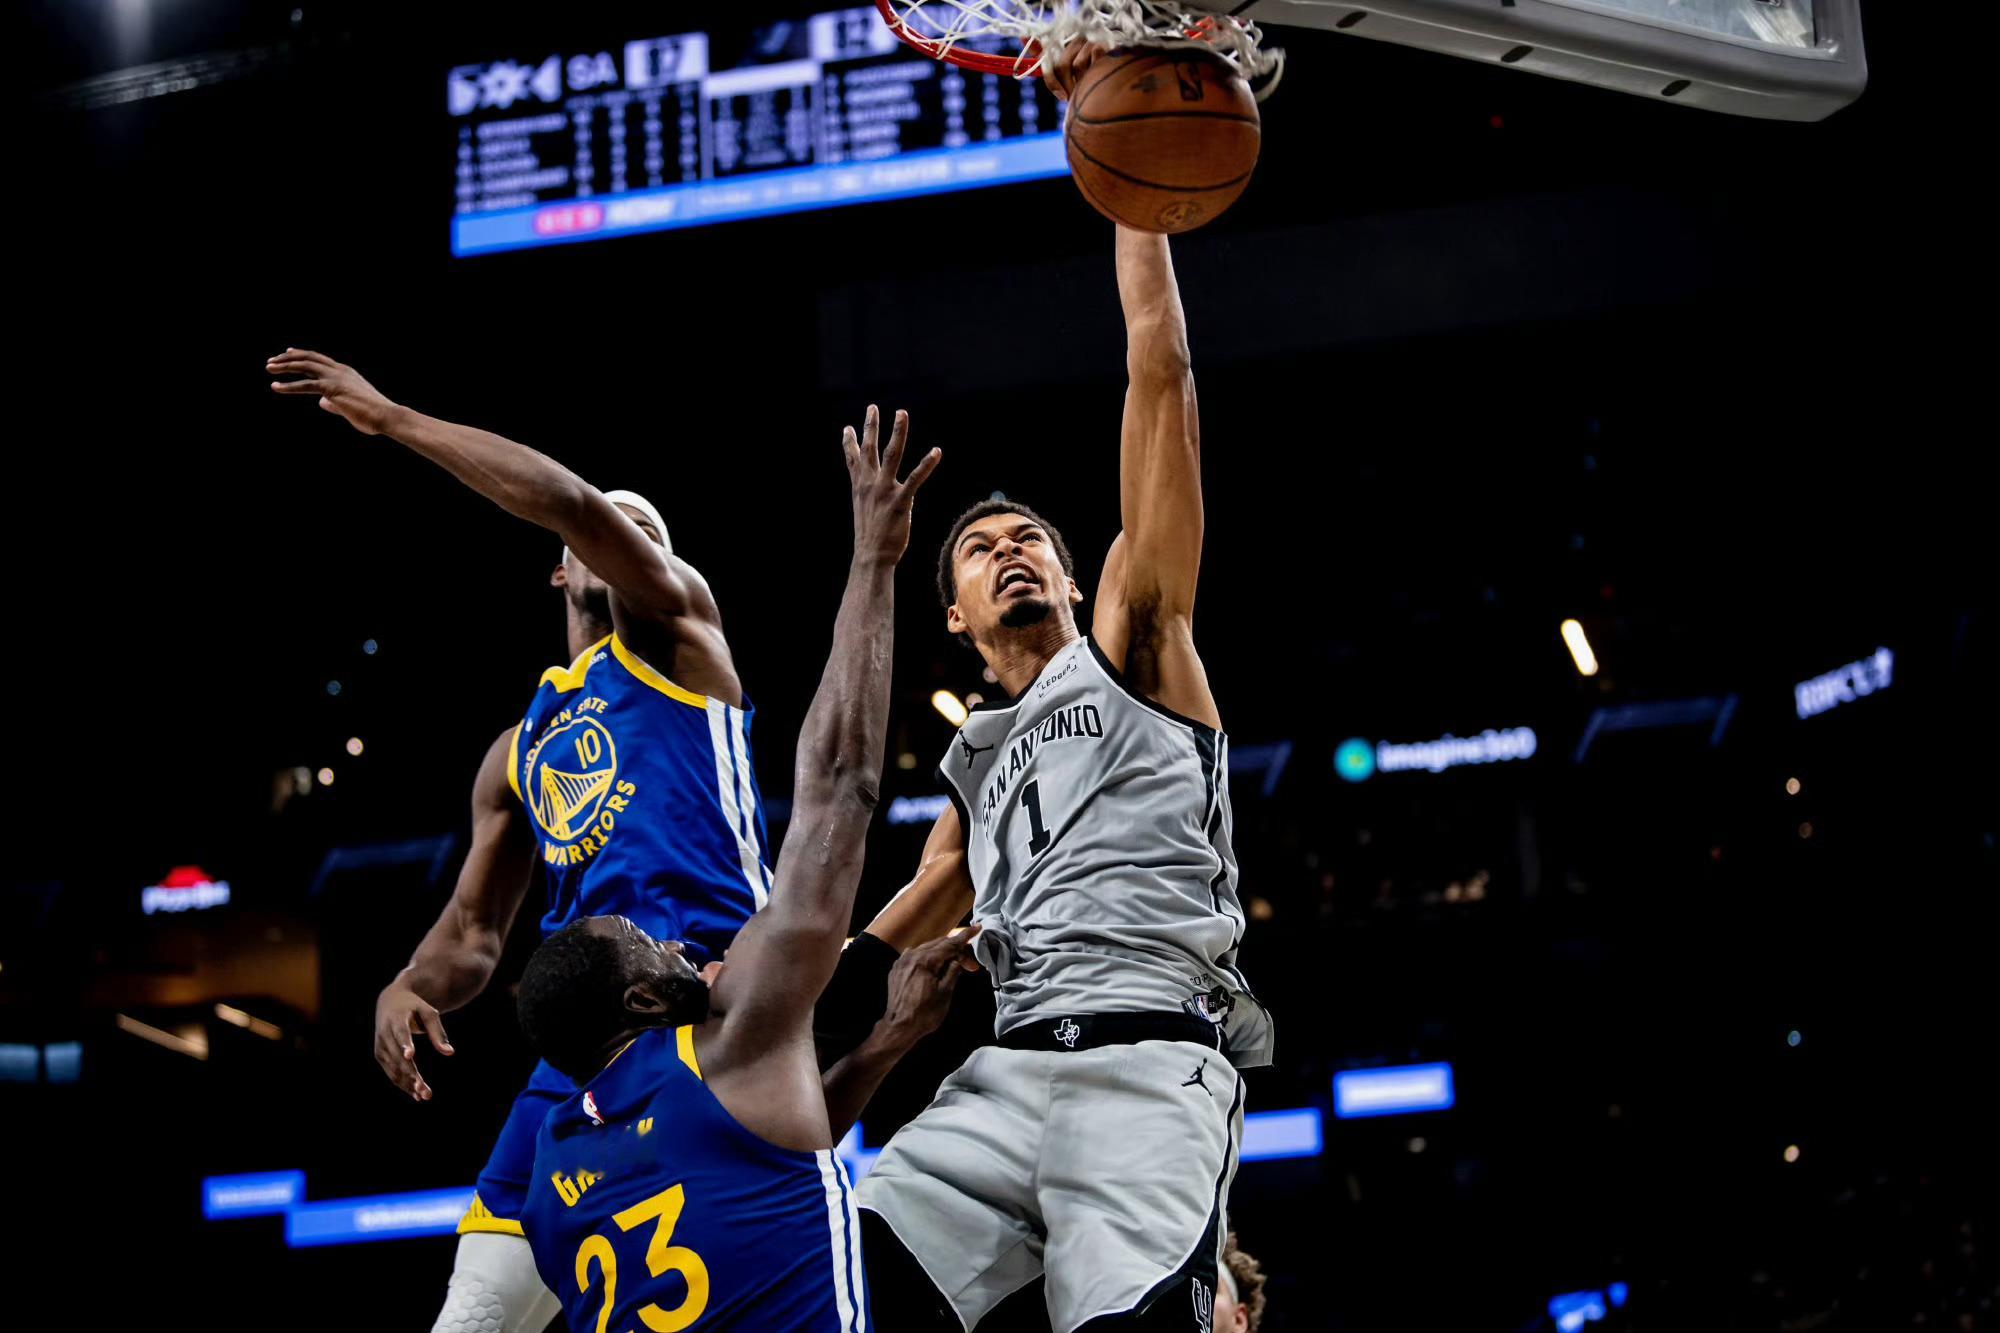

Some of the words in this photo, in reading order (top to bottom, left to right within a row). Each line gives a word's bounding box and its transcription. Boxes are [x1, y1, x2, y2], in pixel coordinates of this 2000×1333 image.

[566, 52, 618, 91] SA
[1041, 663, 1071, 690] LEDGER
[575, 728, 602, 770] 10
[1009, 704, 1104, 781] ANTONIO
[544, 779, 637, 866] WARRIORS
[1020, 778, 1051, 859] 1
[575, 1183, 710, 1333] 23
